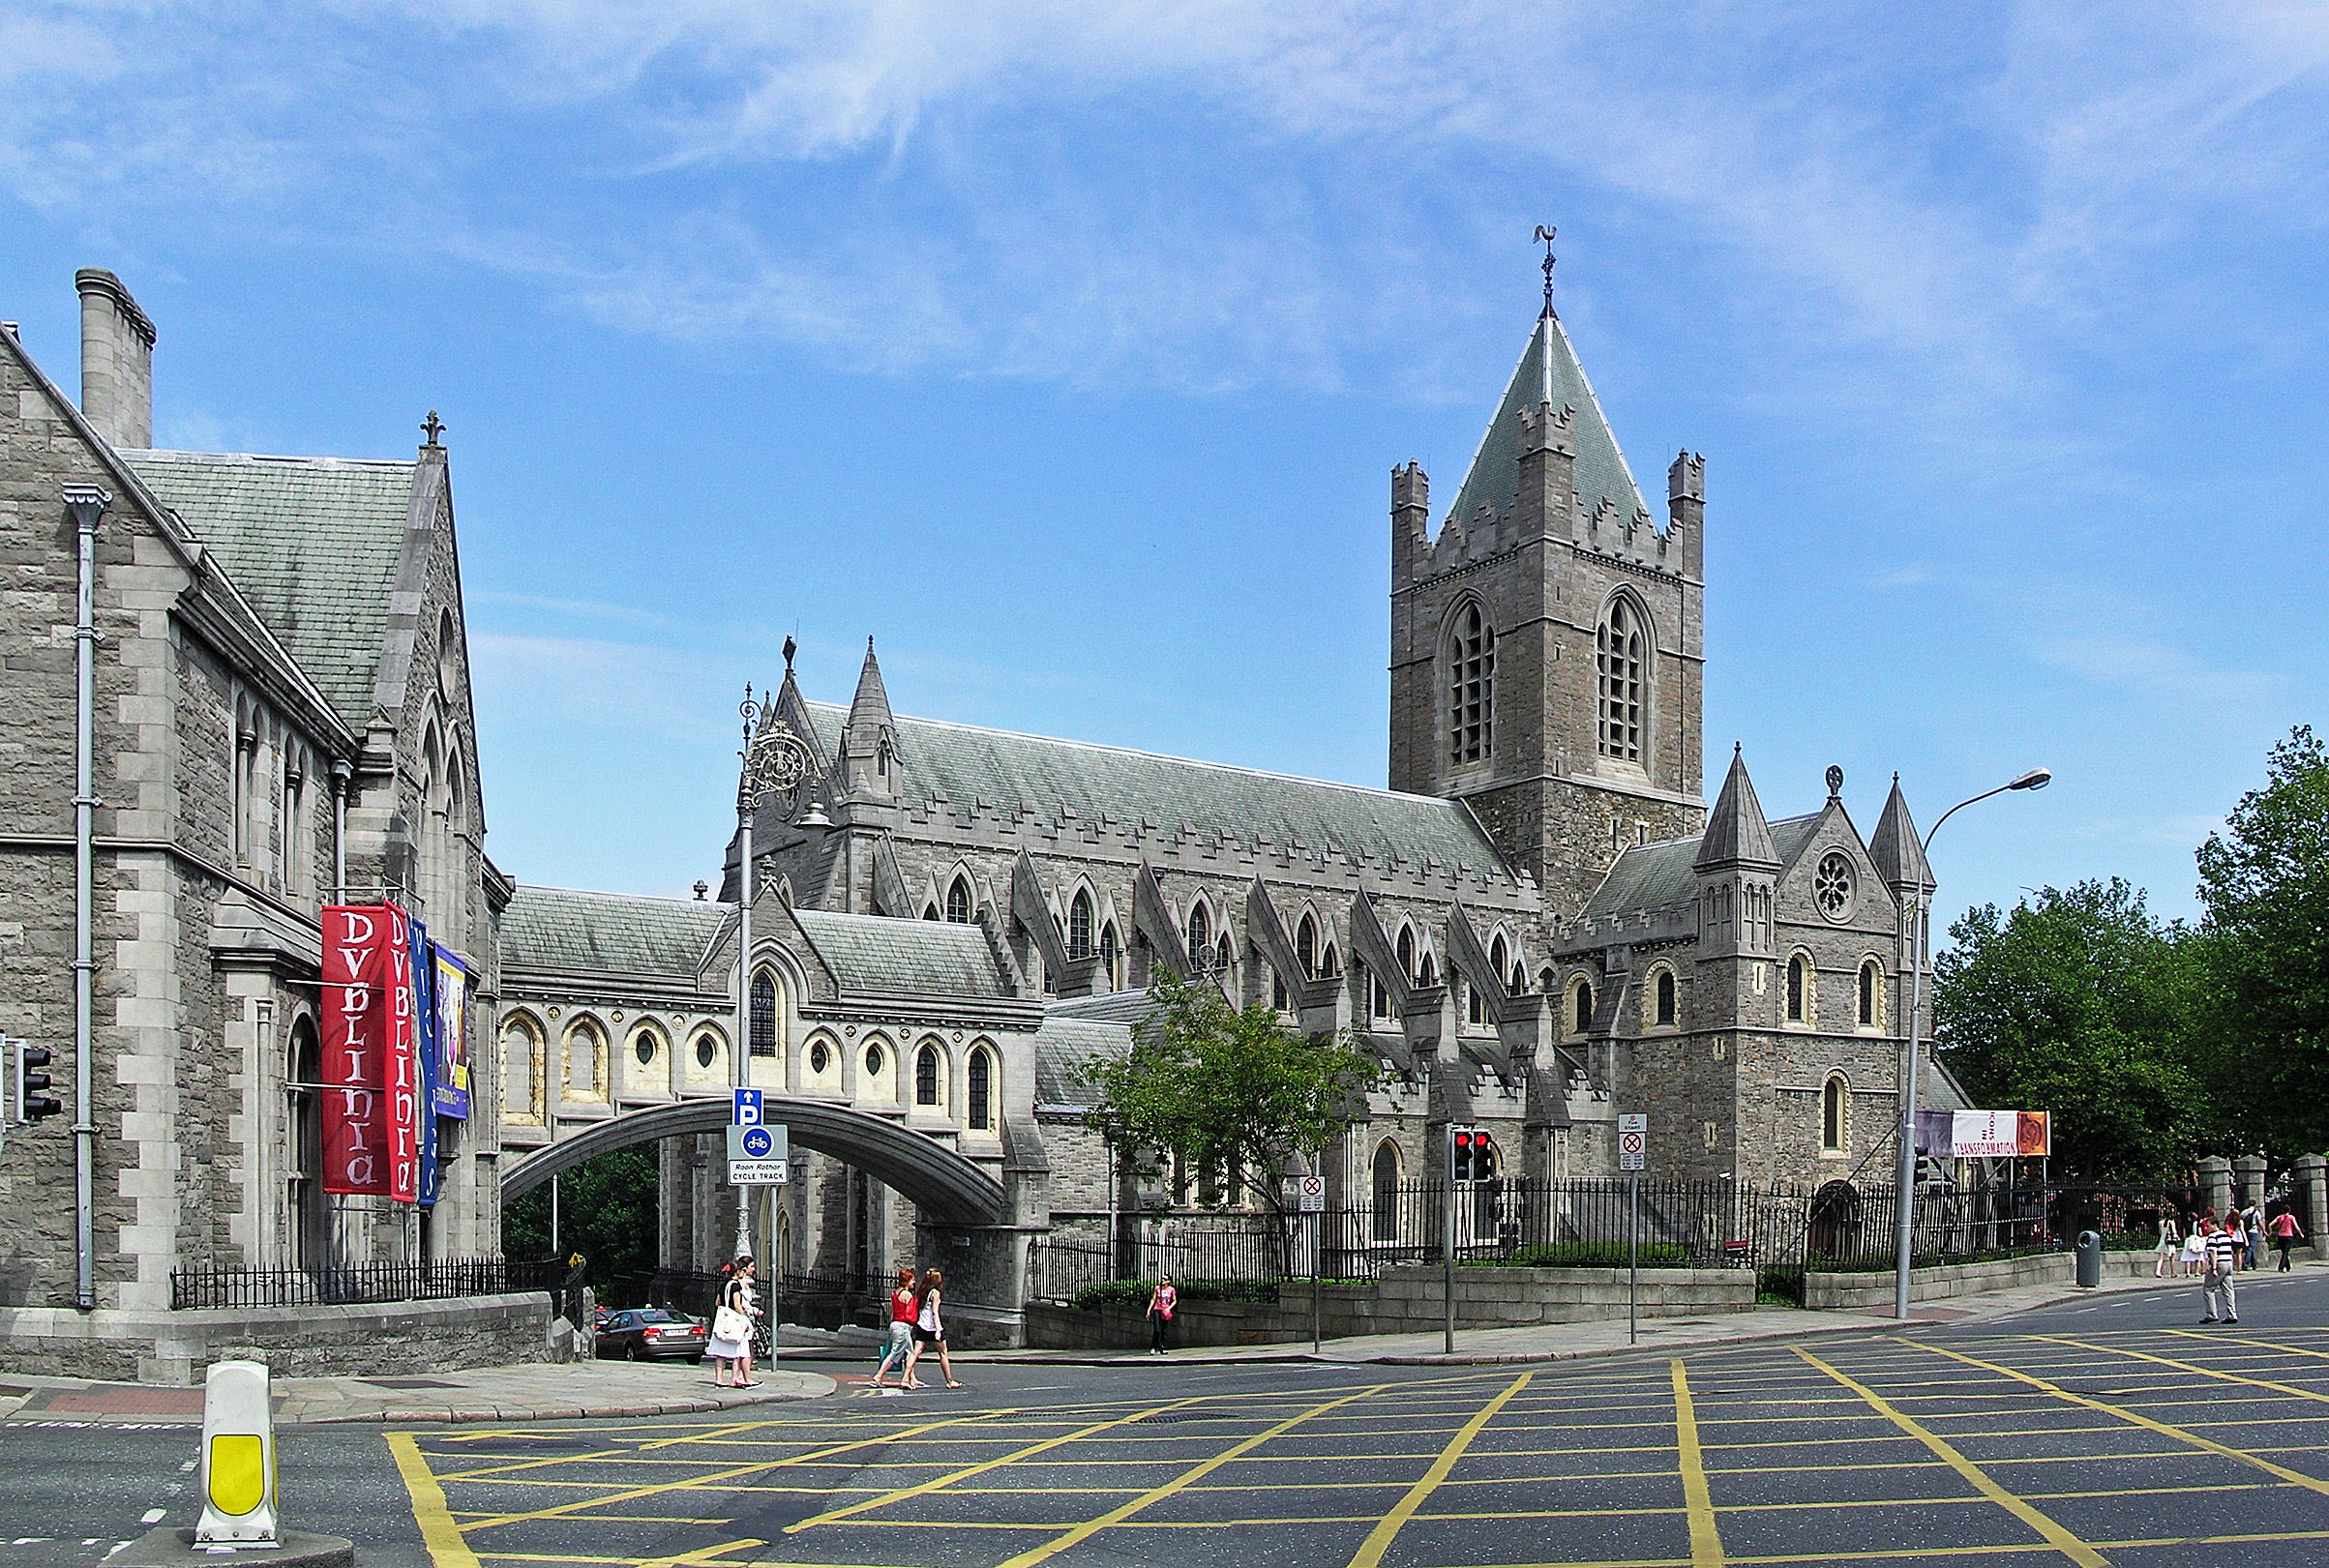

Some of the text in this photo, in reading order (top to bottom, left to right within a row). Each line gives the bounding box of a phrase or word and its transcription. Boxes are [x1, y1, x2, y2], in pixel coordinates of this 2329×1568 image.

[739, 1105, 759, 1126] P
[1982, 1130, 1987, 1140] IN
[1955, 1142, 2015, 1155] TRANSFORMATION
